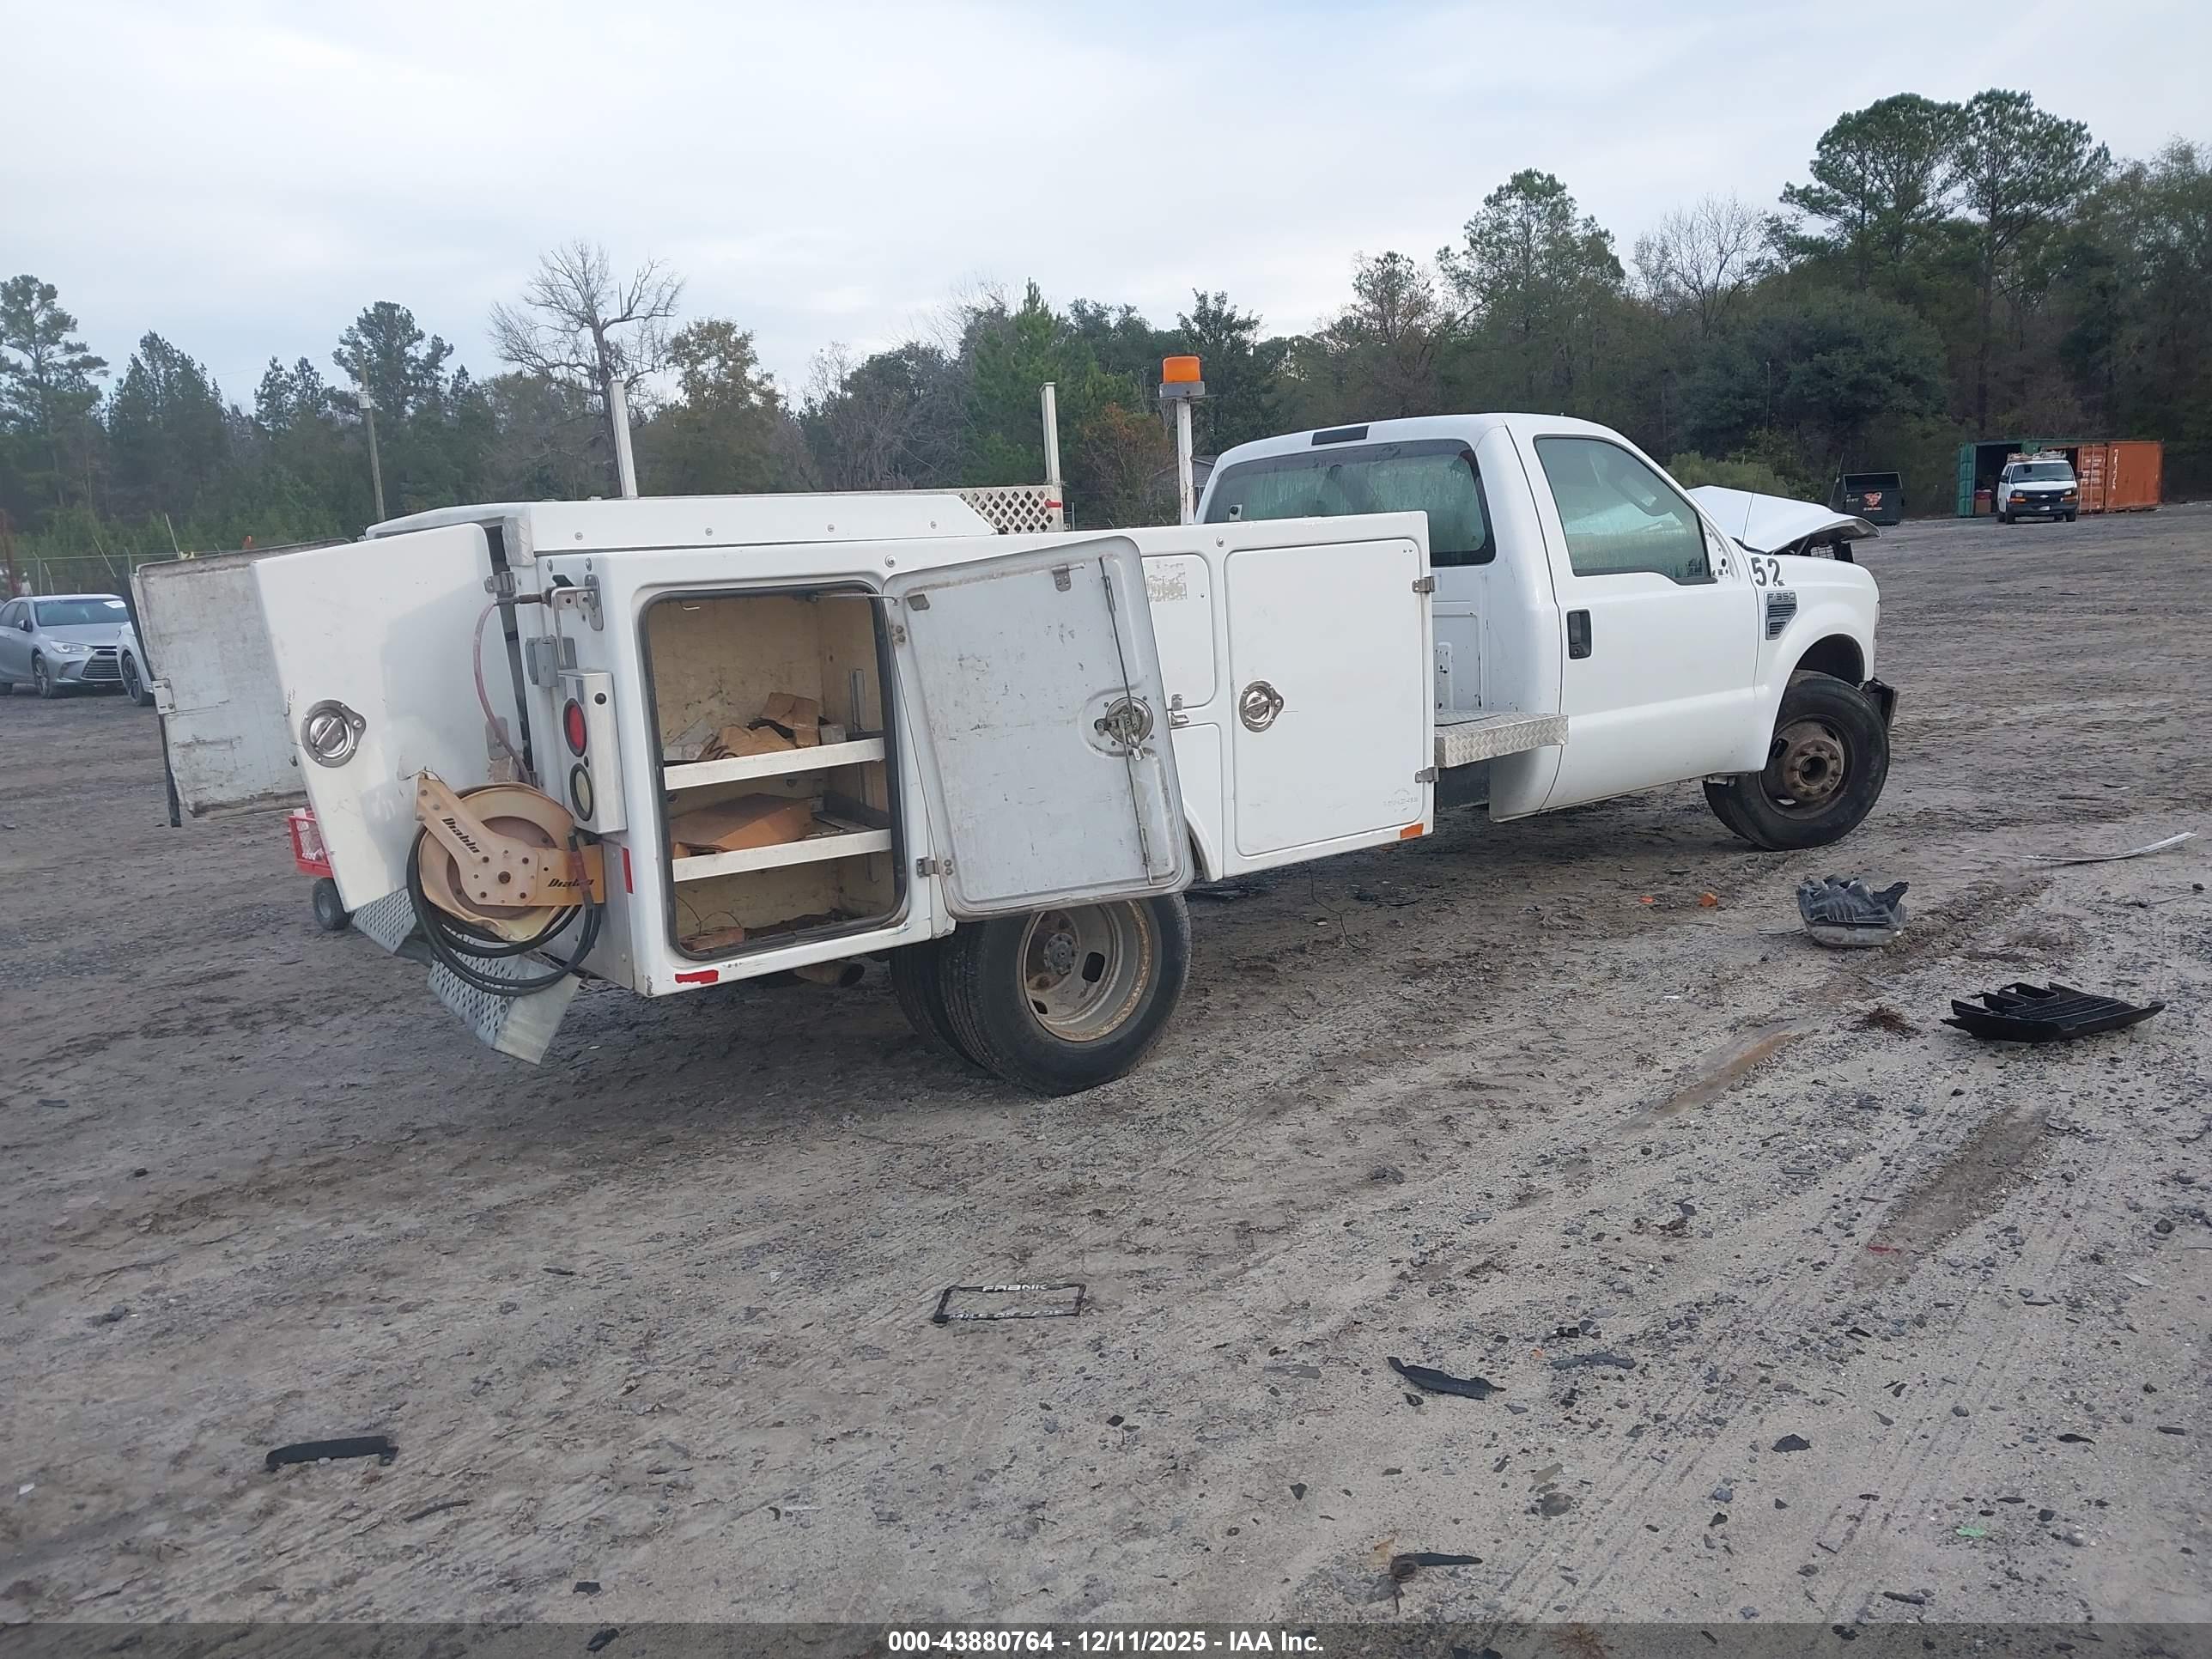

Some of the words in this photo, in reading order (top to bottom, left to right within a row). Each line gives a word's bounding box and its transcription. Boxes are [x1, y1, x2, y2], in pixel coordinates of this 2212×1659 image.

[1750, 556, 1786, 587] 52
[1766, 592, 1796, 601] F-350
[441, 817, 481, 854] Diablo
[547, 878, 594, 888] Diabo
